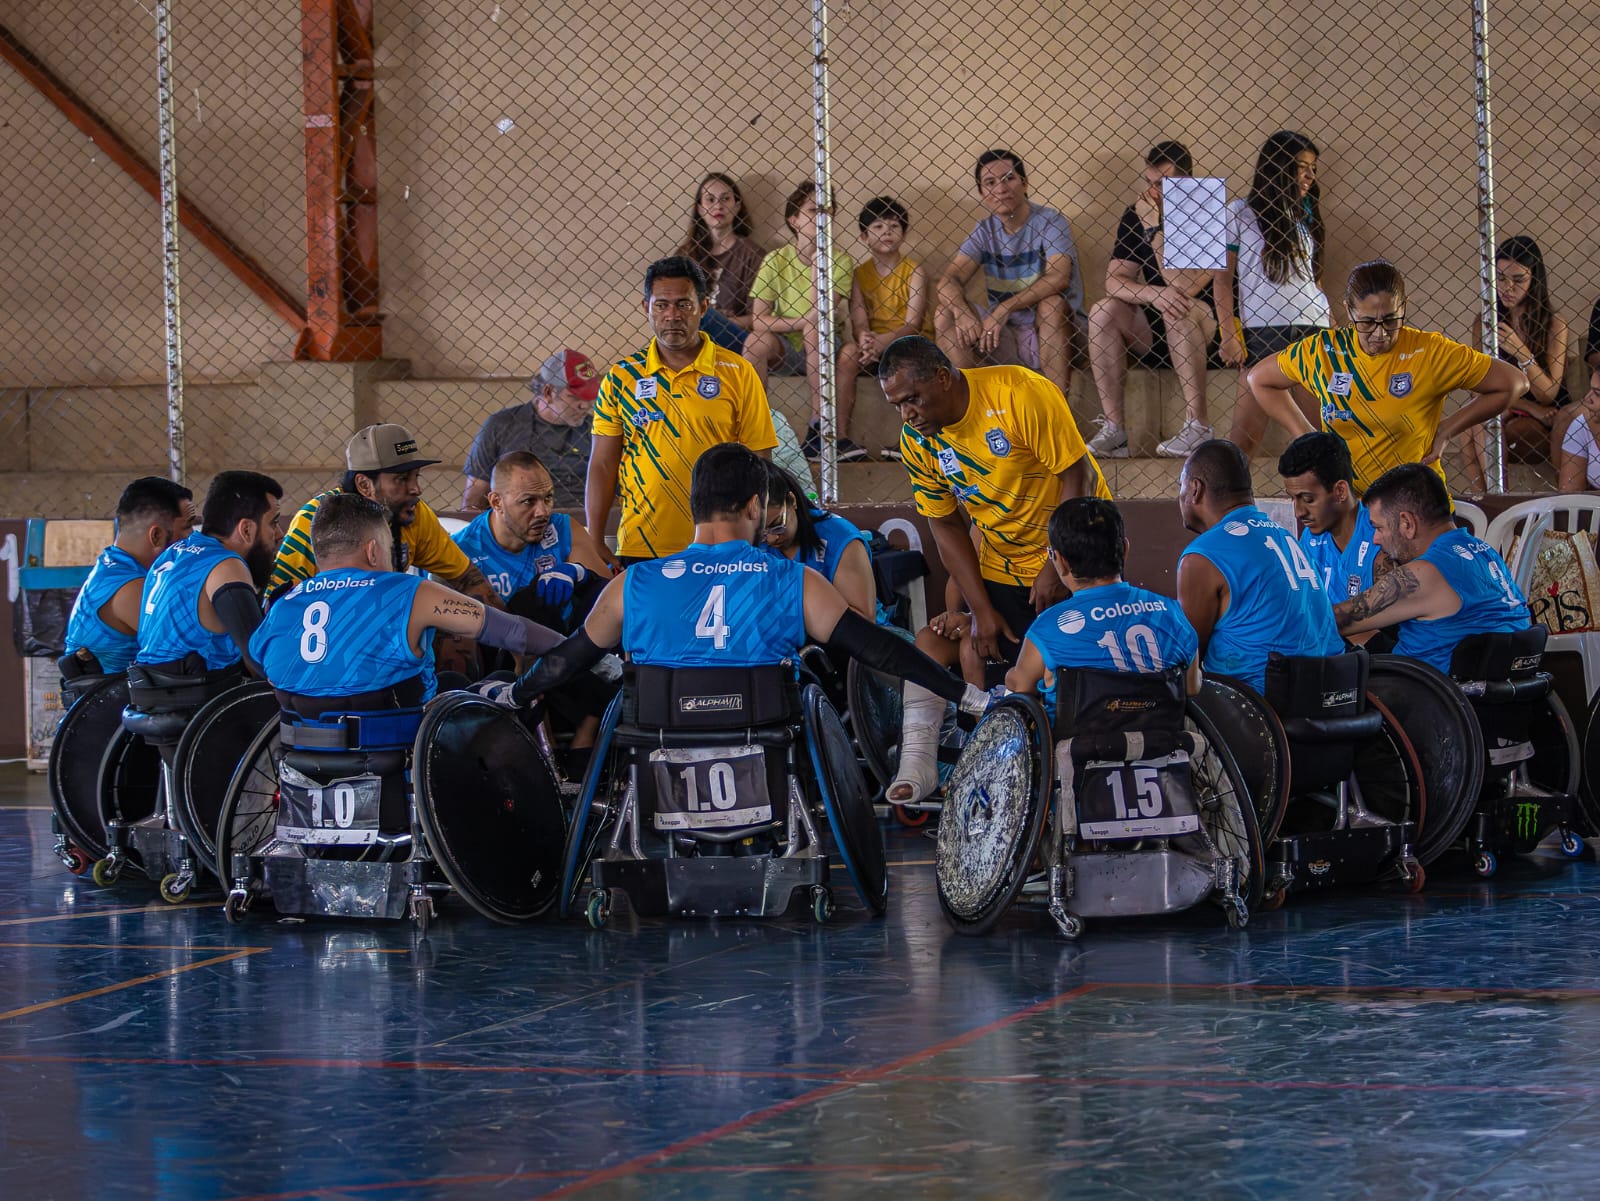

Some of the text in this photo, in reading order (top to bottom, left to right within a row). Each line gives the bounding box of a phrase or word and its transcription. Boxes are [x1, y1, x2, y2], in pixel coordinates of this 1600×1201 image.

[305, 577, 377, 594] Coloplast
[487, 572, 513, 597] 50
[691, 560, 769, 576] Coloplast
[1264, 535, 1320, 591] 14
[300, 601, 331, 664] 8
[695, 584, 731, 650] 4
[1090, 600, 1168, 621] Coloplast
[1096, 624, 1163, 674] 10
[307, 783, 355, 829] 1.0
[679, 761, 737, 811] 1.0
[1106, 768, 1163, 819] 1.5
